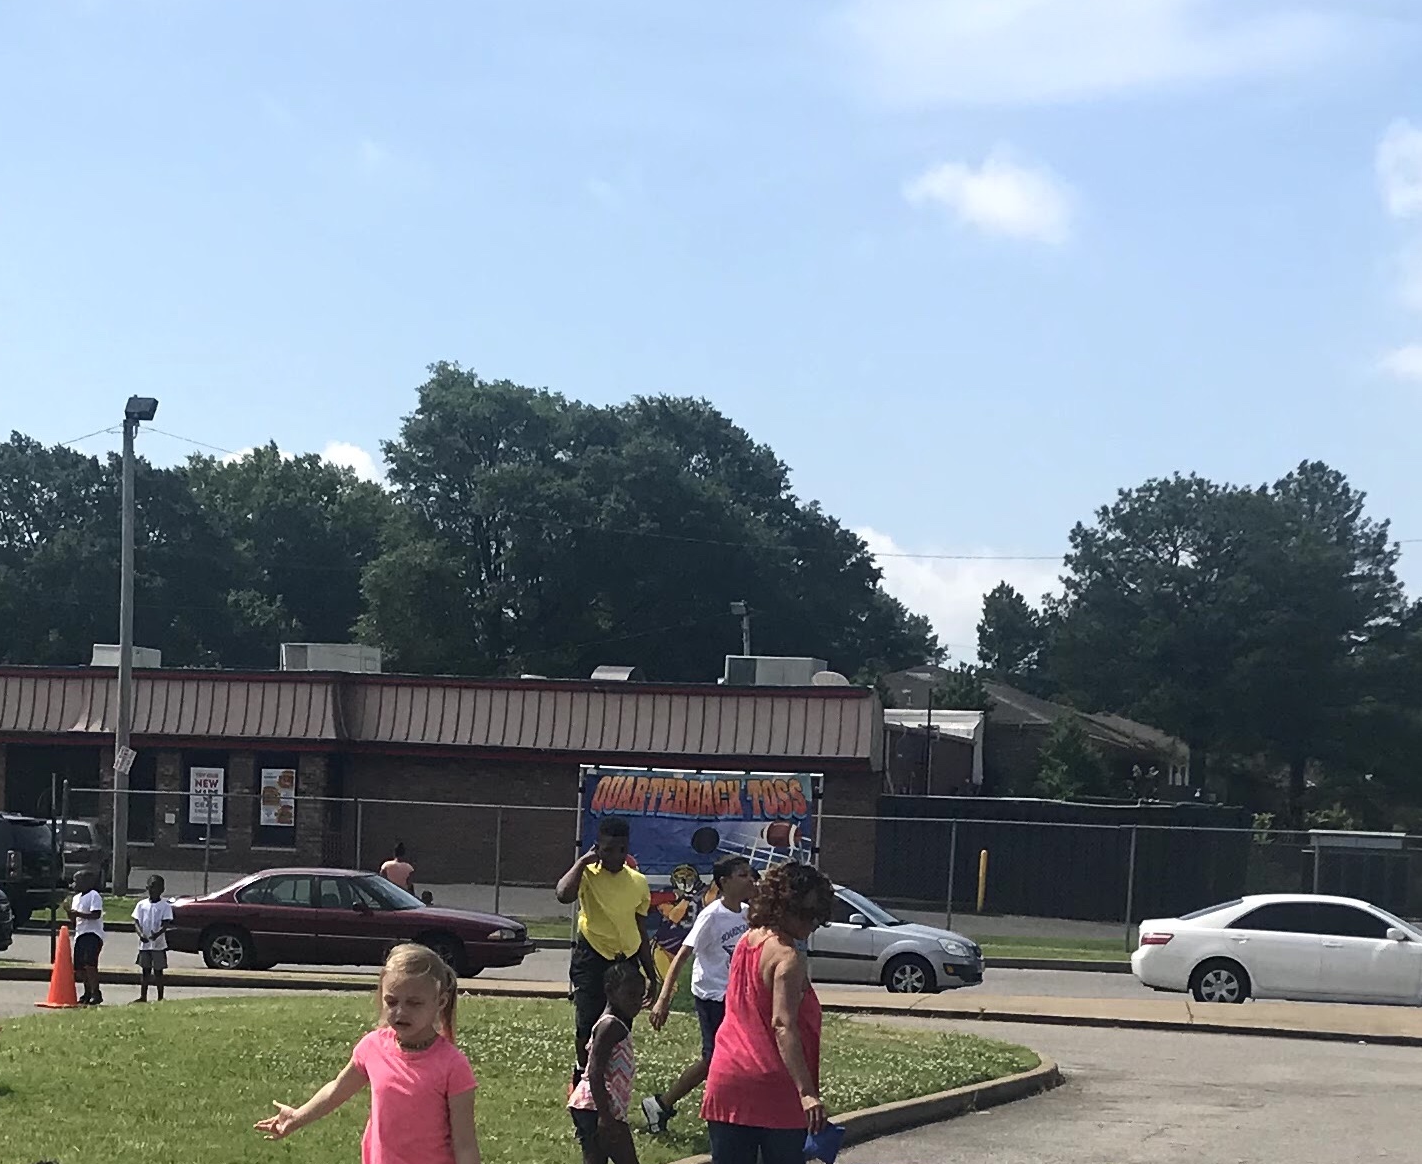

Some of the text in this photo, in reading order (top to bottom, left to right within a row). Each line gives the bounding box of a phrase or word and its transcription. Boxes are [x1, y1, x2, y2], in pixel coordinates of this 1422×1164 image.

[194, 779, 219, 788] NEW
[590, 775, 808, 819] QUARTERBACK TOSS
